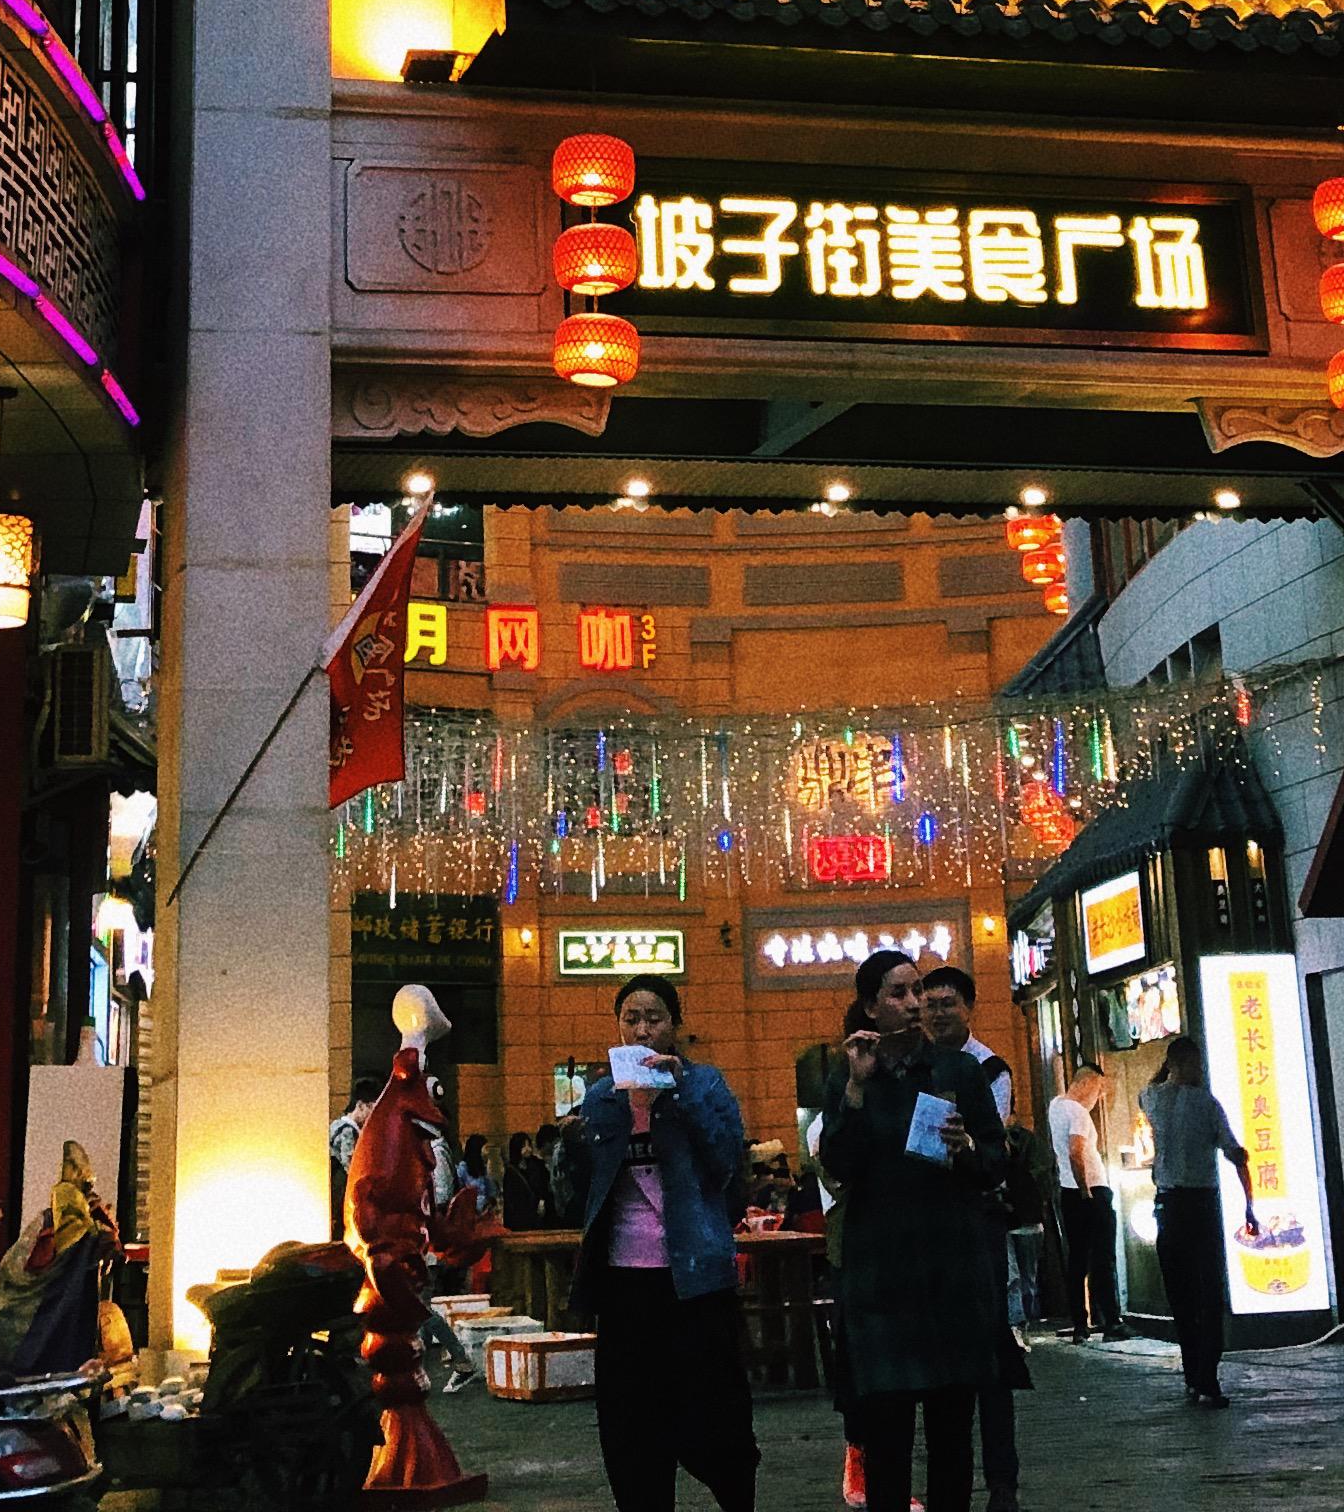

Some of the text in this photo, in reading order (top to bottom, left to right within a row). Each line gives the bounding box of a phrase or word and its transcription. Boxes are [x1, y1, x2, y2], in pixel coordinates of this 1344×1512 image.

[634, 193, 1209, 312] 坡子街美食广场
[1240, 994, 1280, 1191] 老长沙臭豆腐
